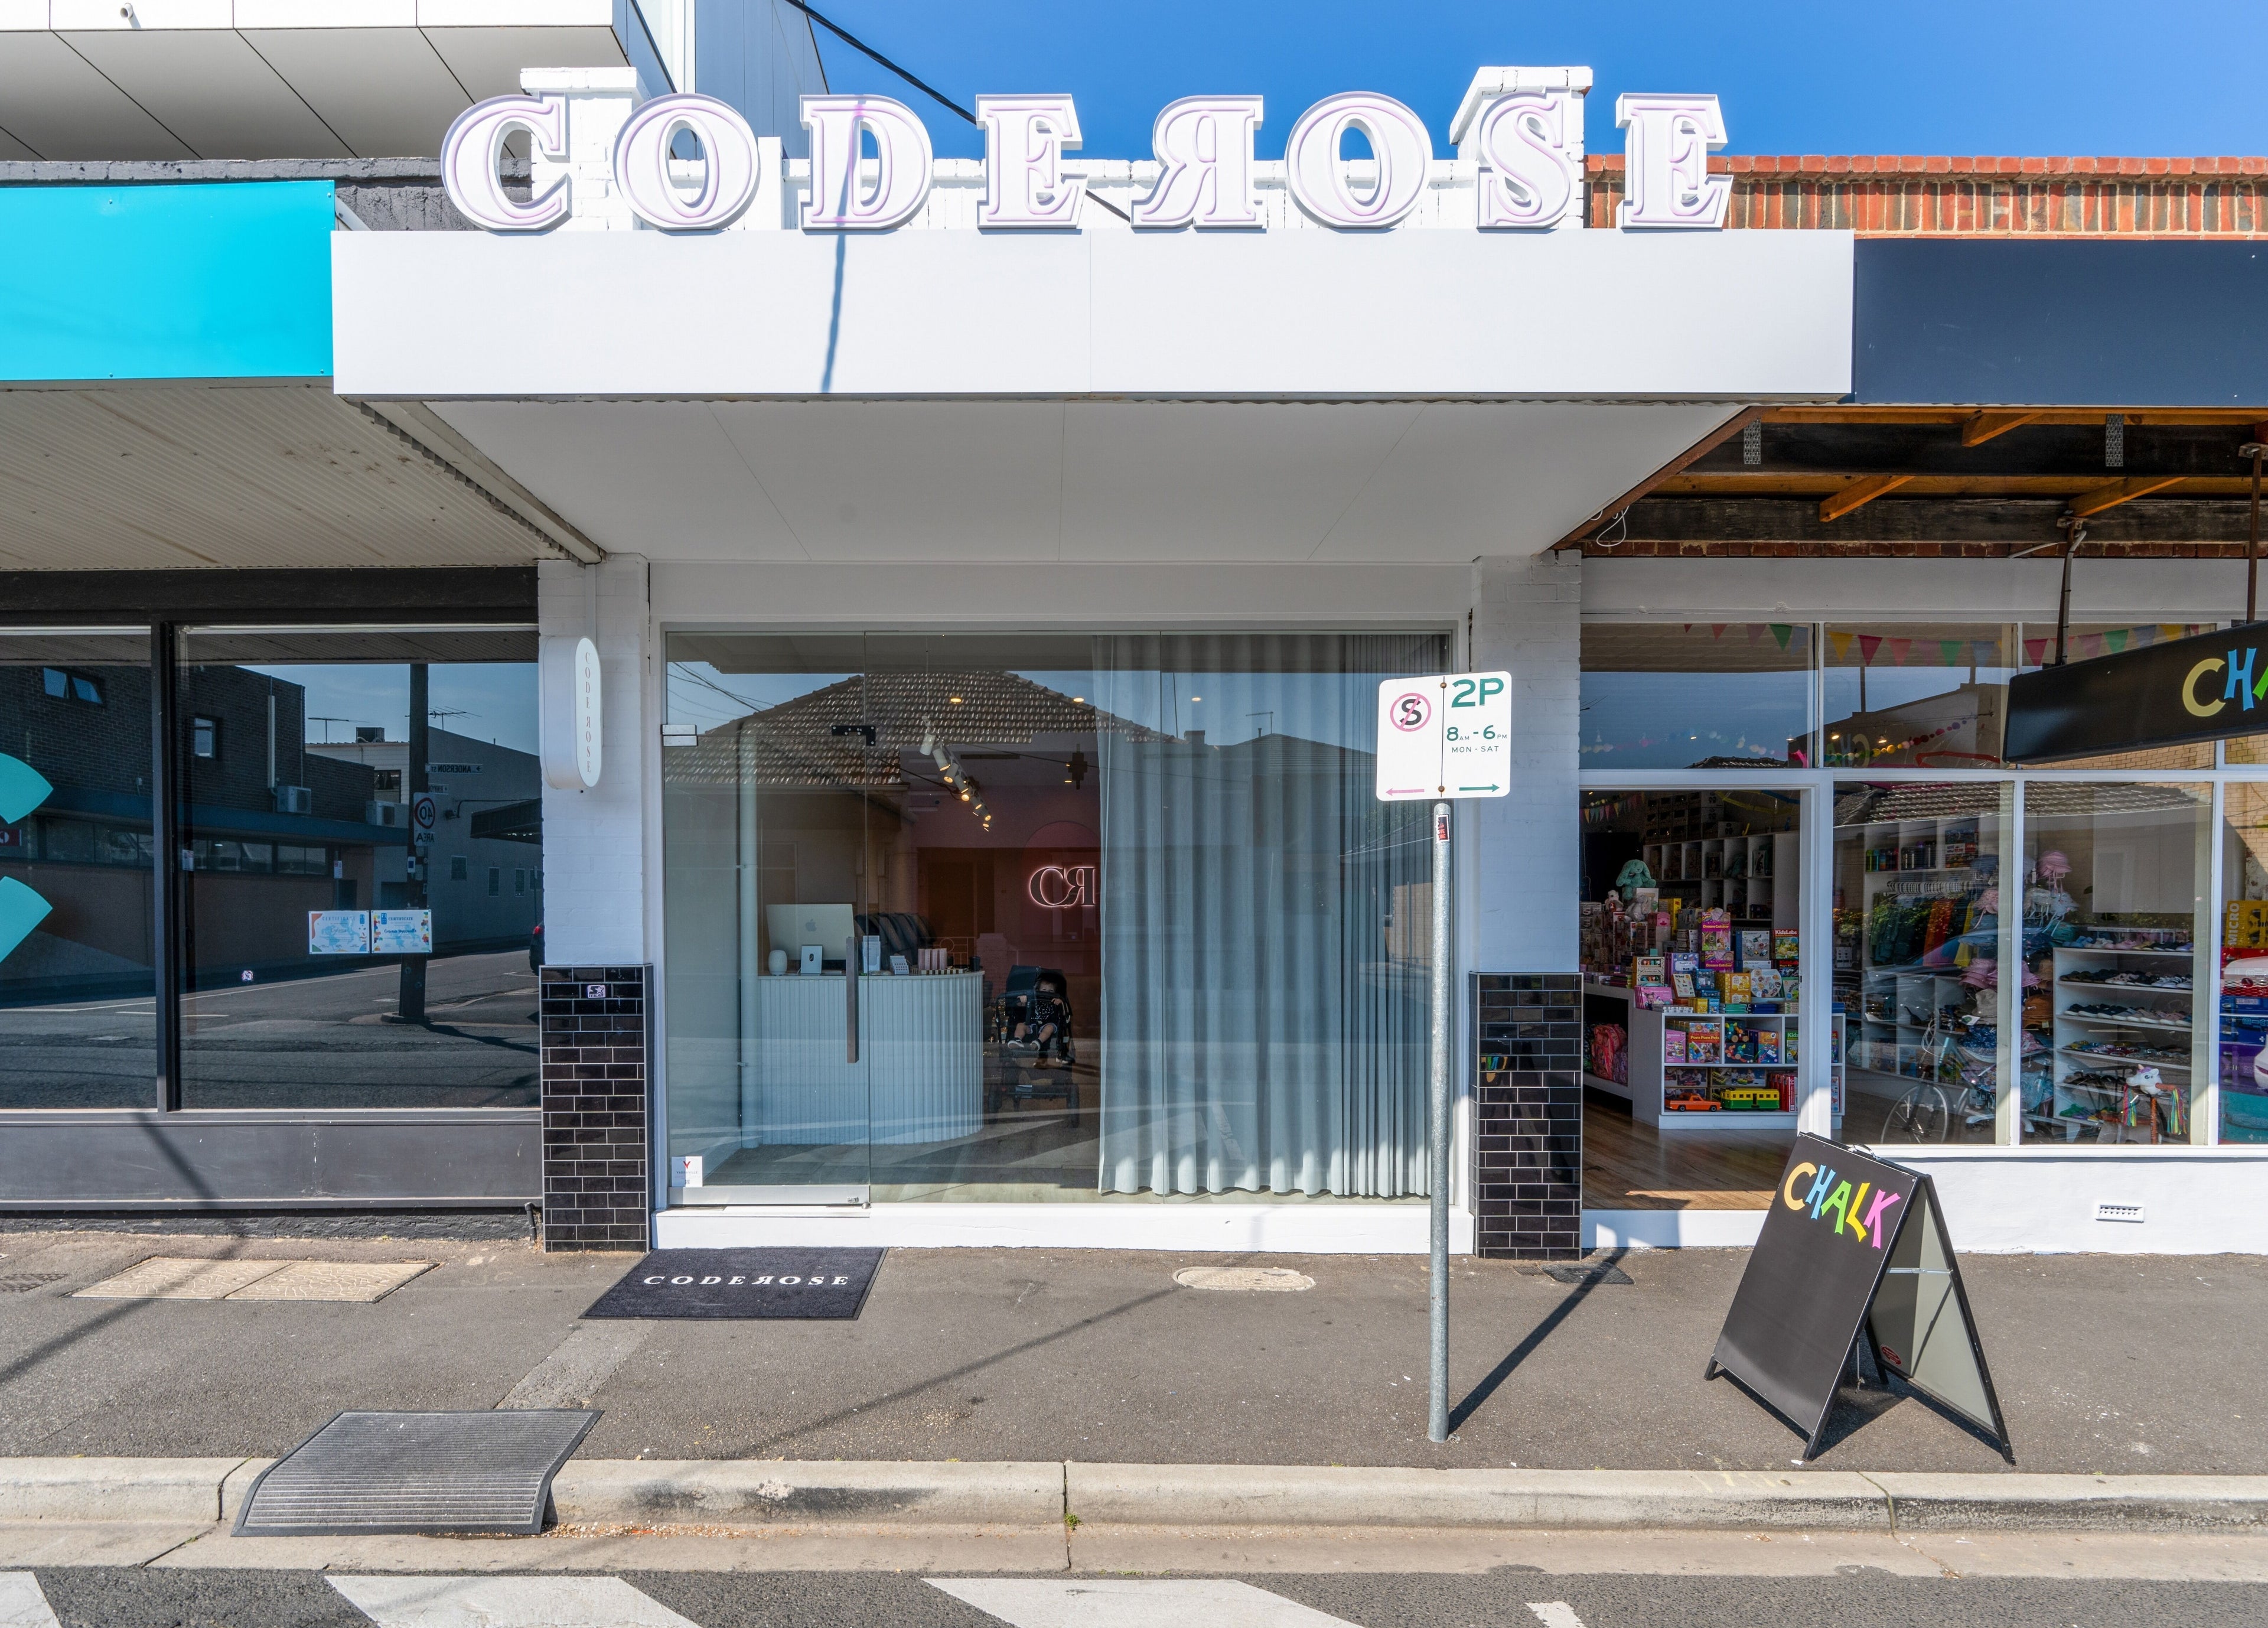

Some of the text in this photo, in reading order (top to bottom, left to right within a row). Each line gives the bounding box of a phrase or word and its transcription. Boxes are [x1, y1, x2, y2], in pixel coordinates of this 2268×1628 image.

[1451, 678, 1504, 708] 2P
[2227, 903, 2240, 945] MICRO
[1784, 1161, 1901, 1249] CHALK
